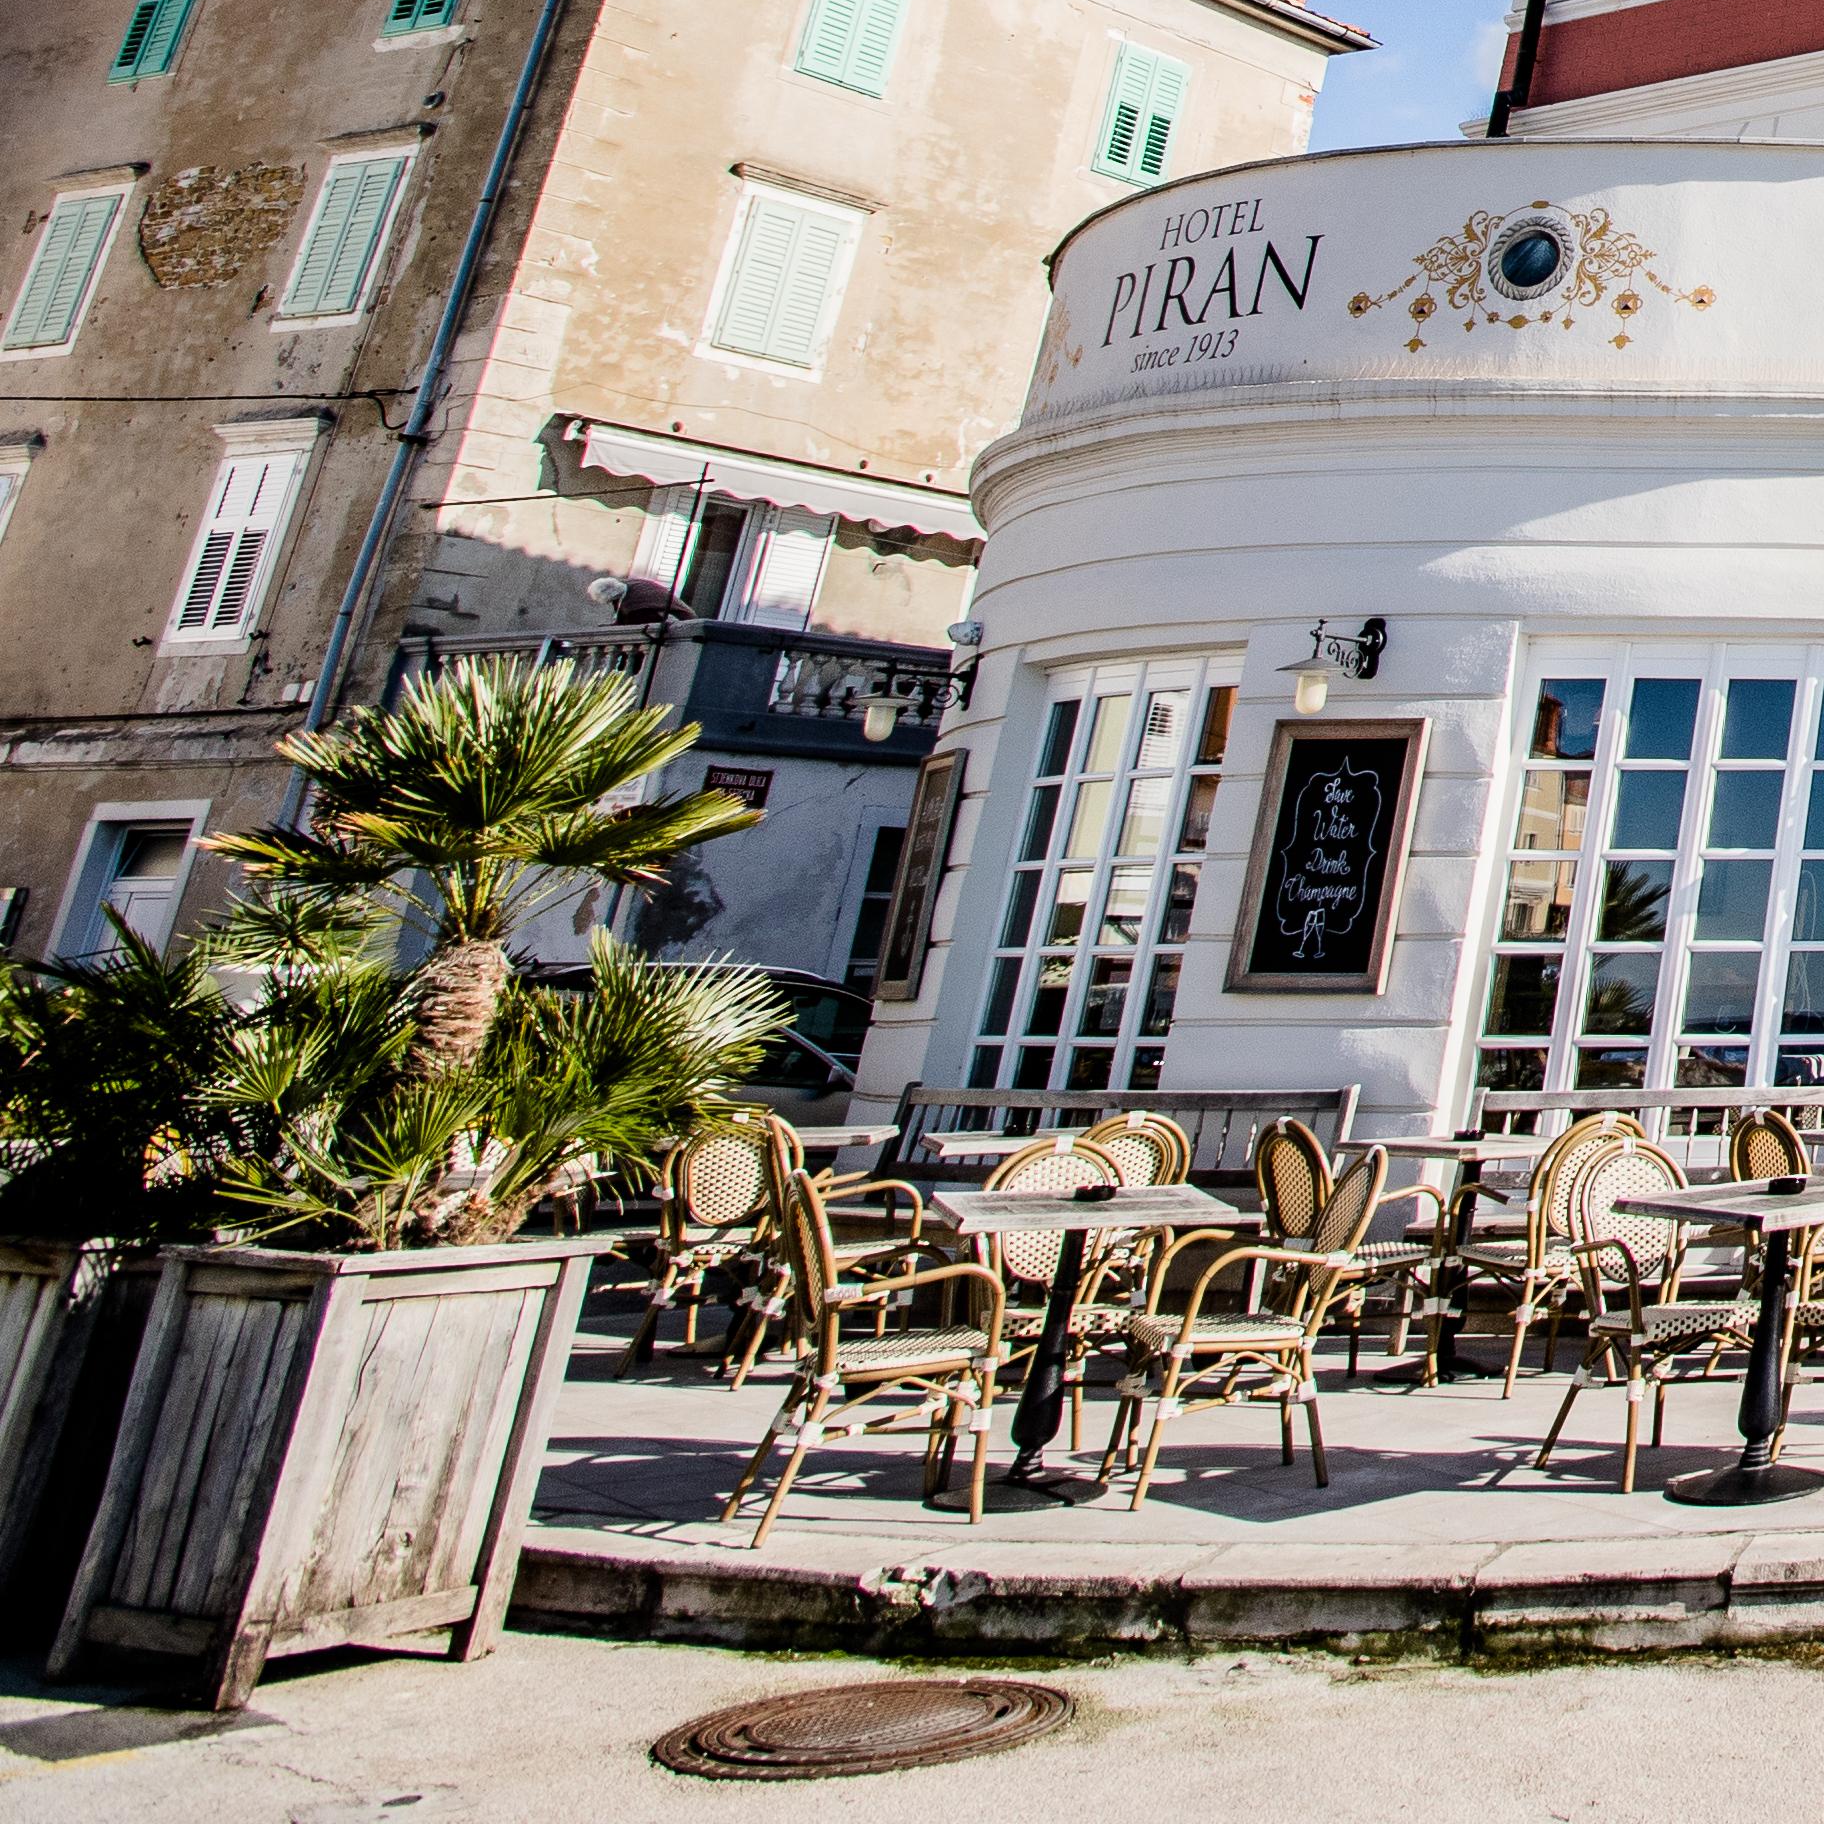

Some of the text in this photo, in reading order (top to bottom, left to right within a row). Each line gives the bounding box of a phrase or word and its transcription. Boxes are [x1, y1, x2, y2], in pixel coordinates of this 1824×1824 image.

[1160, 198, 1265, 251] HOTEL
[1100, 234, 1326, 349] PIRAN
[1130, 328, 1240, 374] since 1913
[1324, 778, 1355, 804] Save
[1313, 805, 1359, 841] Water
[1305, 847, 1351, 875] Drink
[1284, 874, 1357, 910] Champagne
